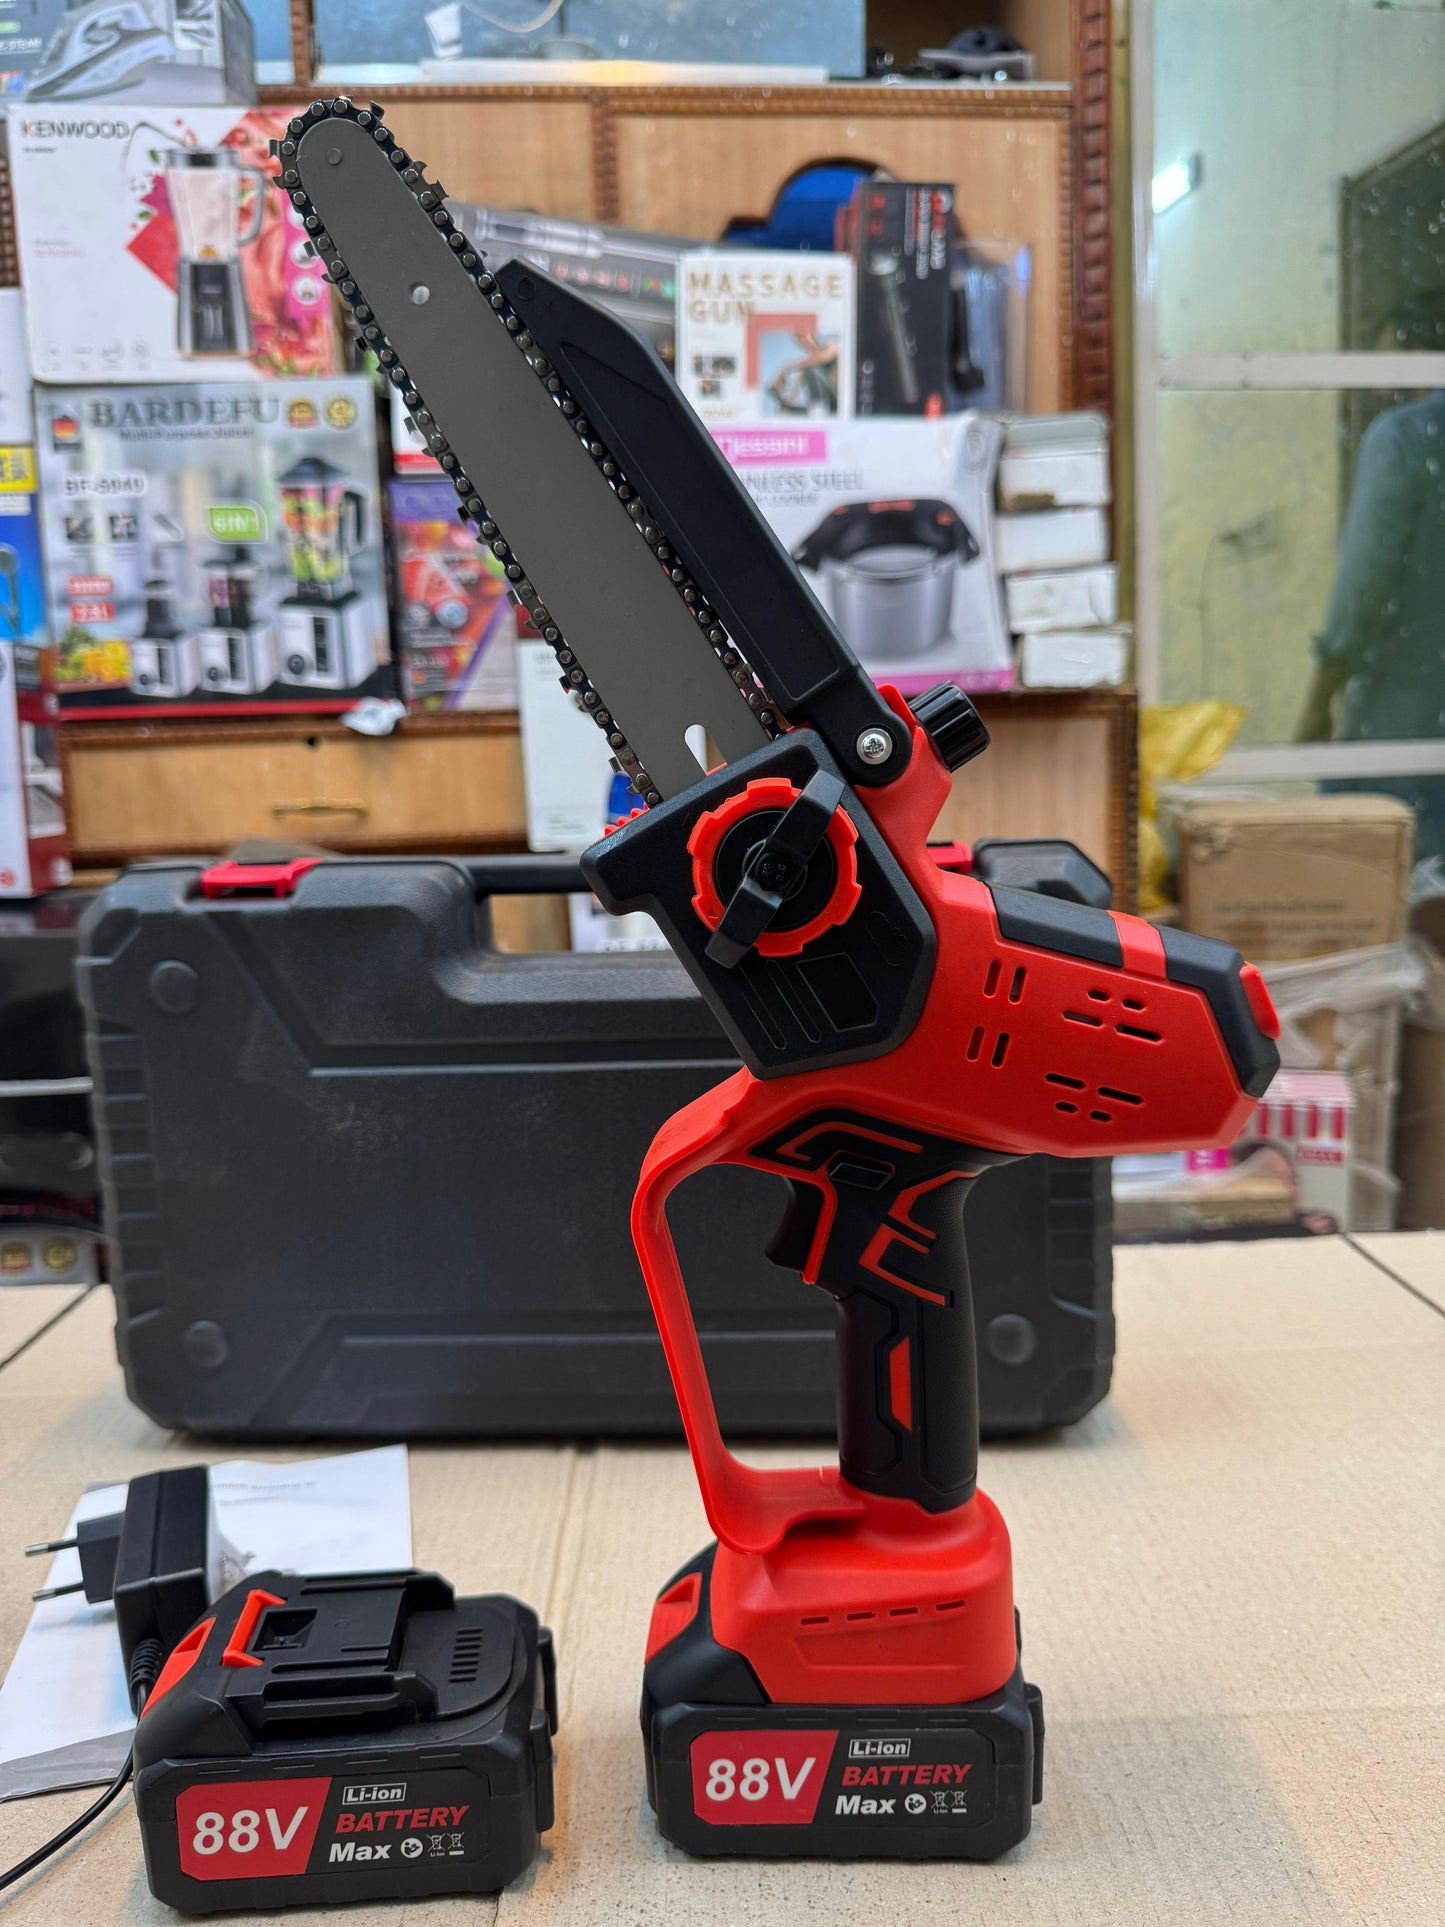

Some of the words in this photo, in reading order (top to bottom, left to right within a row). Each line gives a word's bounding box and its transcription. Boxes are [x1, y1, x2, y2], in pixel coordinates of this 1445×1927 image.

[21, 120, 131, 139] KENWOOD
[689, 271, 843, 298] MASSAGE
[688, 299, 755, 324] GUN
[90, 397, 281, 427] BARDEFU
[852, 1741, 907, 1755] Li-ion
[705, 1757, 816, 1801] 88V
[841, 1764, 972, 1786] BATTERY
[346, 1786, 402, 1802] Li-ion
[835, 1795, 896, 1815] Max
[193, 1806, 309, 1855] 88V
[335, 1805, 470, 1833] BATTERY
[328, 1842, 392, 1862] Max
